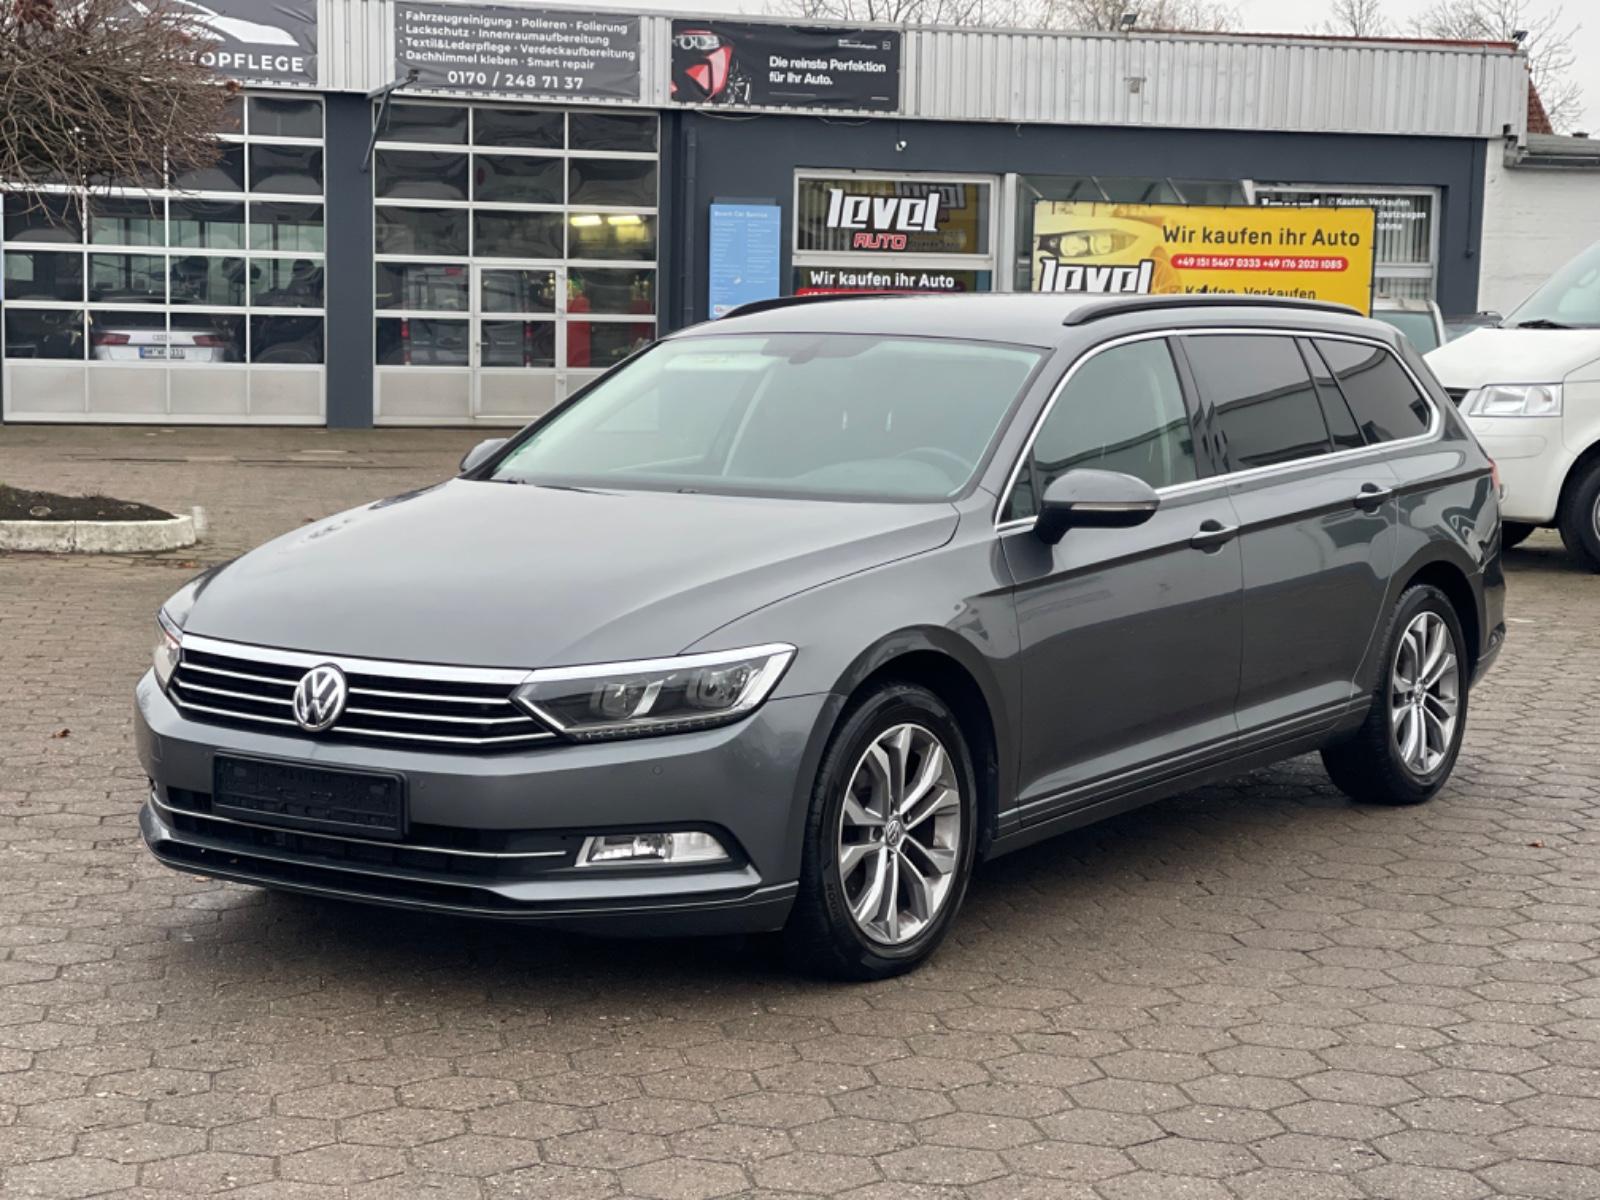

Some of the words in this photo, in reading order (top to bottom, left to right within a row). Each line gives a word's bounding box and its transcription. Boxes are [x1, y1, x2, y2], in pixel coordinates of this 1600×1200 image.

[405, 11, 512, 28] Fahrzeugreinigung
[521, 18, 567, 30] Polieren
[576, 20, 628, 35] Folierung
[405, 24, 469, 37] Lackschutz
[479, 29, 610, 47] Innenraumaufbereitung
[405, 37, 511, 54] Textil&Lederpflege
[520, 43, 636, 61] Verdeckaufbereitung
[405, 50, 477, 63] Dachhimmel
[480, 54, 519, 66] kleben
[527, 57, 560, 68] Smart
[563, 60, 595, 71] repair
[769, 55, 788, 68] Die
[790, 57, 828, 70] reinste
[830, 58, 887, 73] Perfektion
[448, 70, 487, 85] 0170
[505, 73, 536, 87] 248
[542, 75, 559, 88] 71
[564, 76, 583, 89] 37
[769, 71, 786, 83] für
[787, 72, 802, 83] Ihr
[804, 72, 833, 85] Auto.
[826, 188, 941, 232] level
[853, 232, 907, 250] AUTO
[1162, 225, 1196, 243] Wir
[1202, 226, 1272, 245] kaufen
[1279, 227, 1307, 245] ihr
[1312, 228, 1360, 247] Auto
[1177, 257, 1194, 266] +49
[1262, 258, 1280, 268] +49
[810, 271, 836, 285] Wir
[839, 271, 892, 286] kaufen
[895, 272, 916, 287] ihr
[919, 273, 955, 288] Auto
